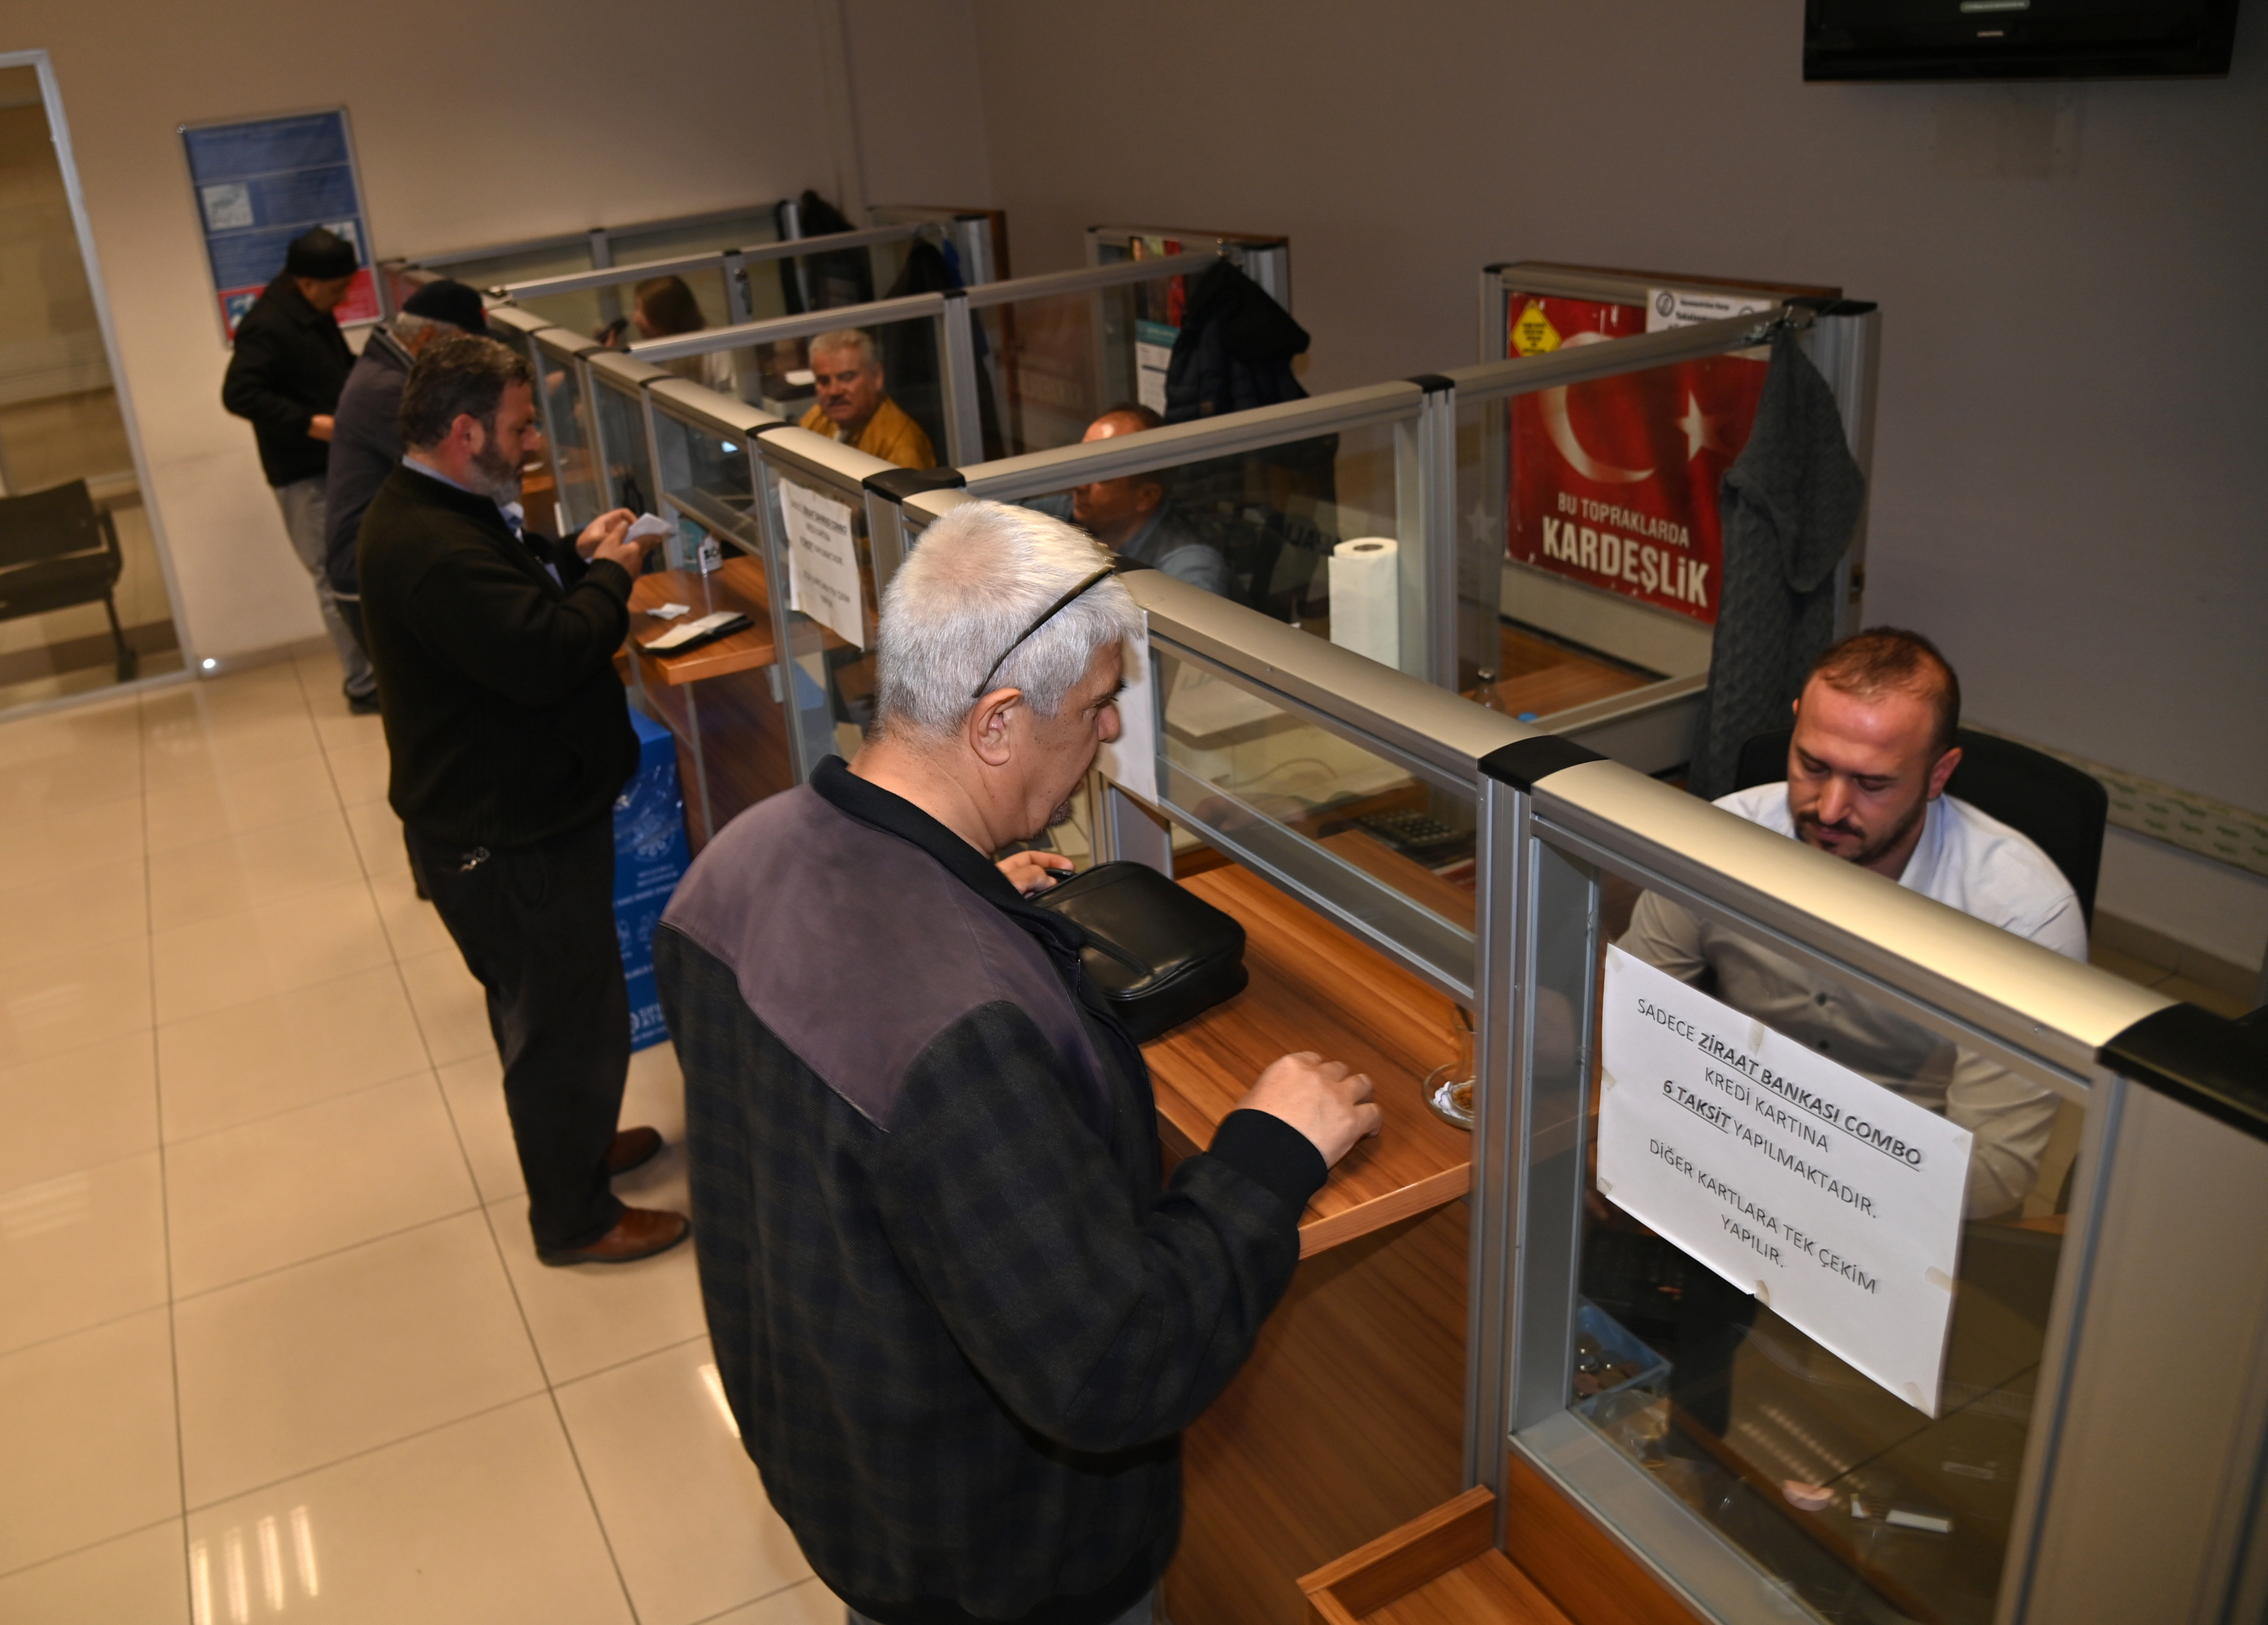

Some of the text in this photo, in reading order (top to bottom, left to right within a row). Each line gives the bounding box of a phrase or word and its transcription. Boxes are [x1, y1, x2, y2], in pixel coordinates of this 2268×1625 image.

[1543, 516, 1710, 609] KARDEŞLİK
[1558, 492, 1690, 548] BU TOPRAKLARDA
[1637, 999, 1921, 1166] SADECE ZİRAAT BANKASI COMBO
[1704, 1067, 1829, 1153] KREDİ KARTINA
[1663, 1079, 1876, 1219] 6 TAKSİT YAPILMAKTADIR.
[1649, 1138, 1876, 1294] DİĞER KARTLARA TEK ÇEKİM
[1720, 1213, 1784, 1269] YAPILIR.
